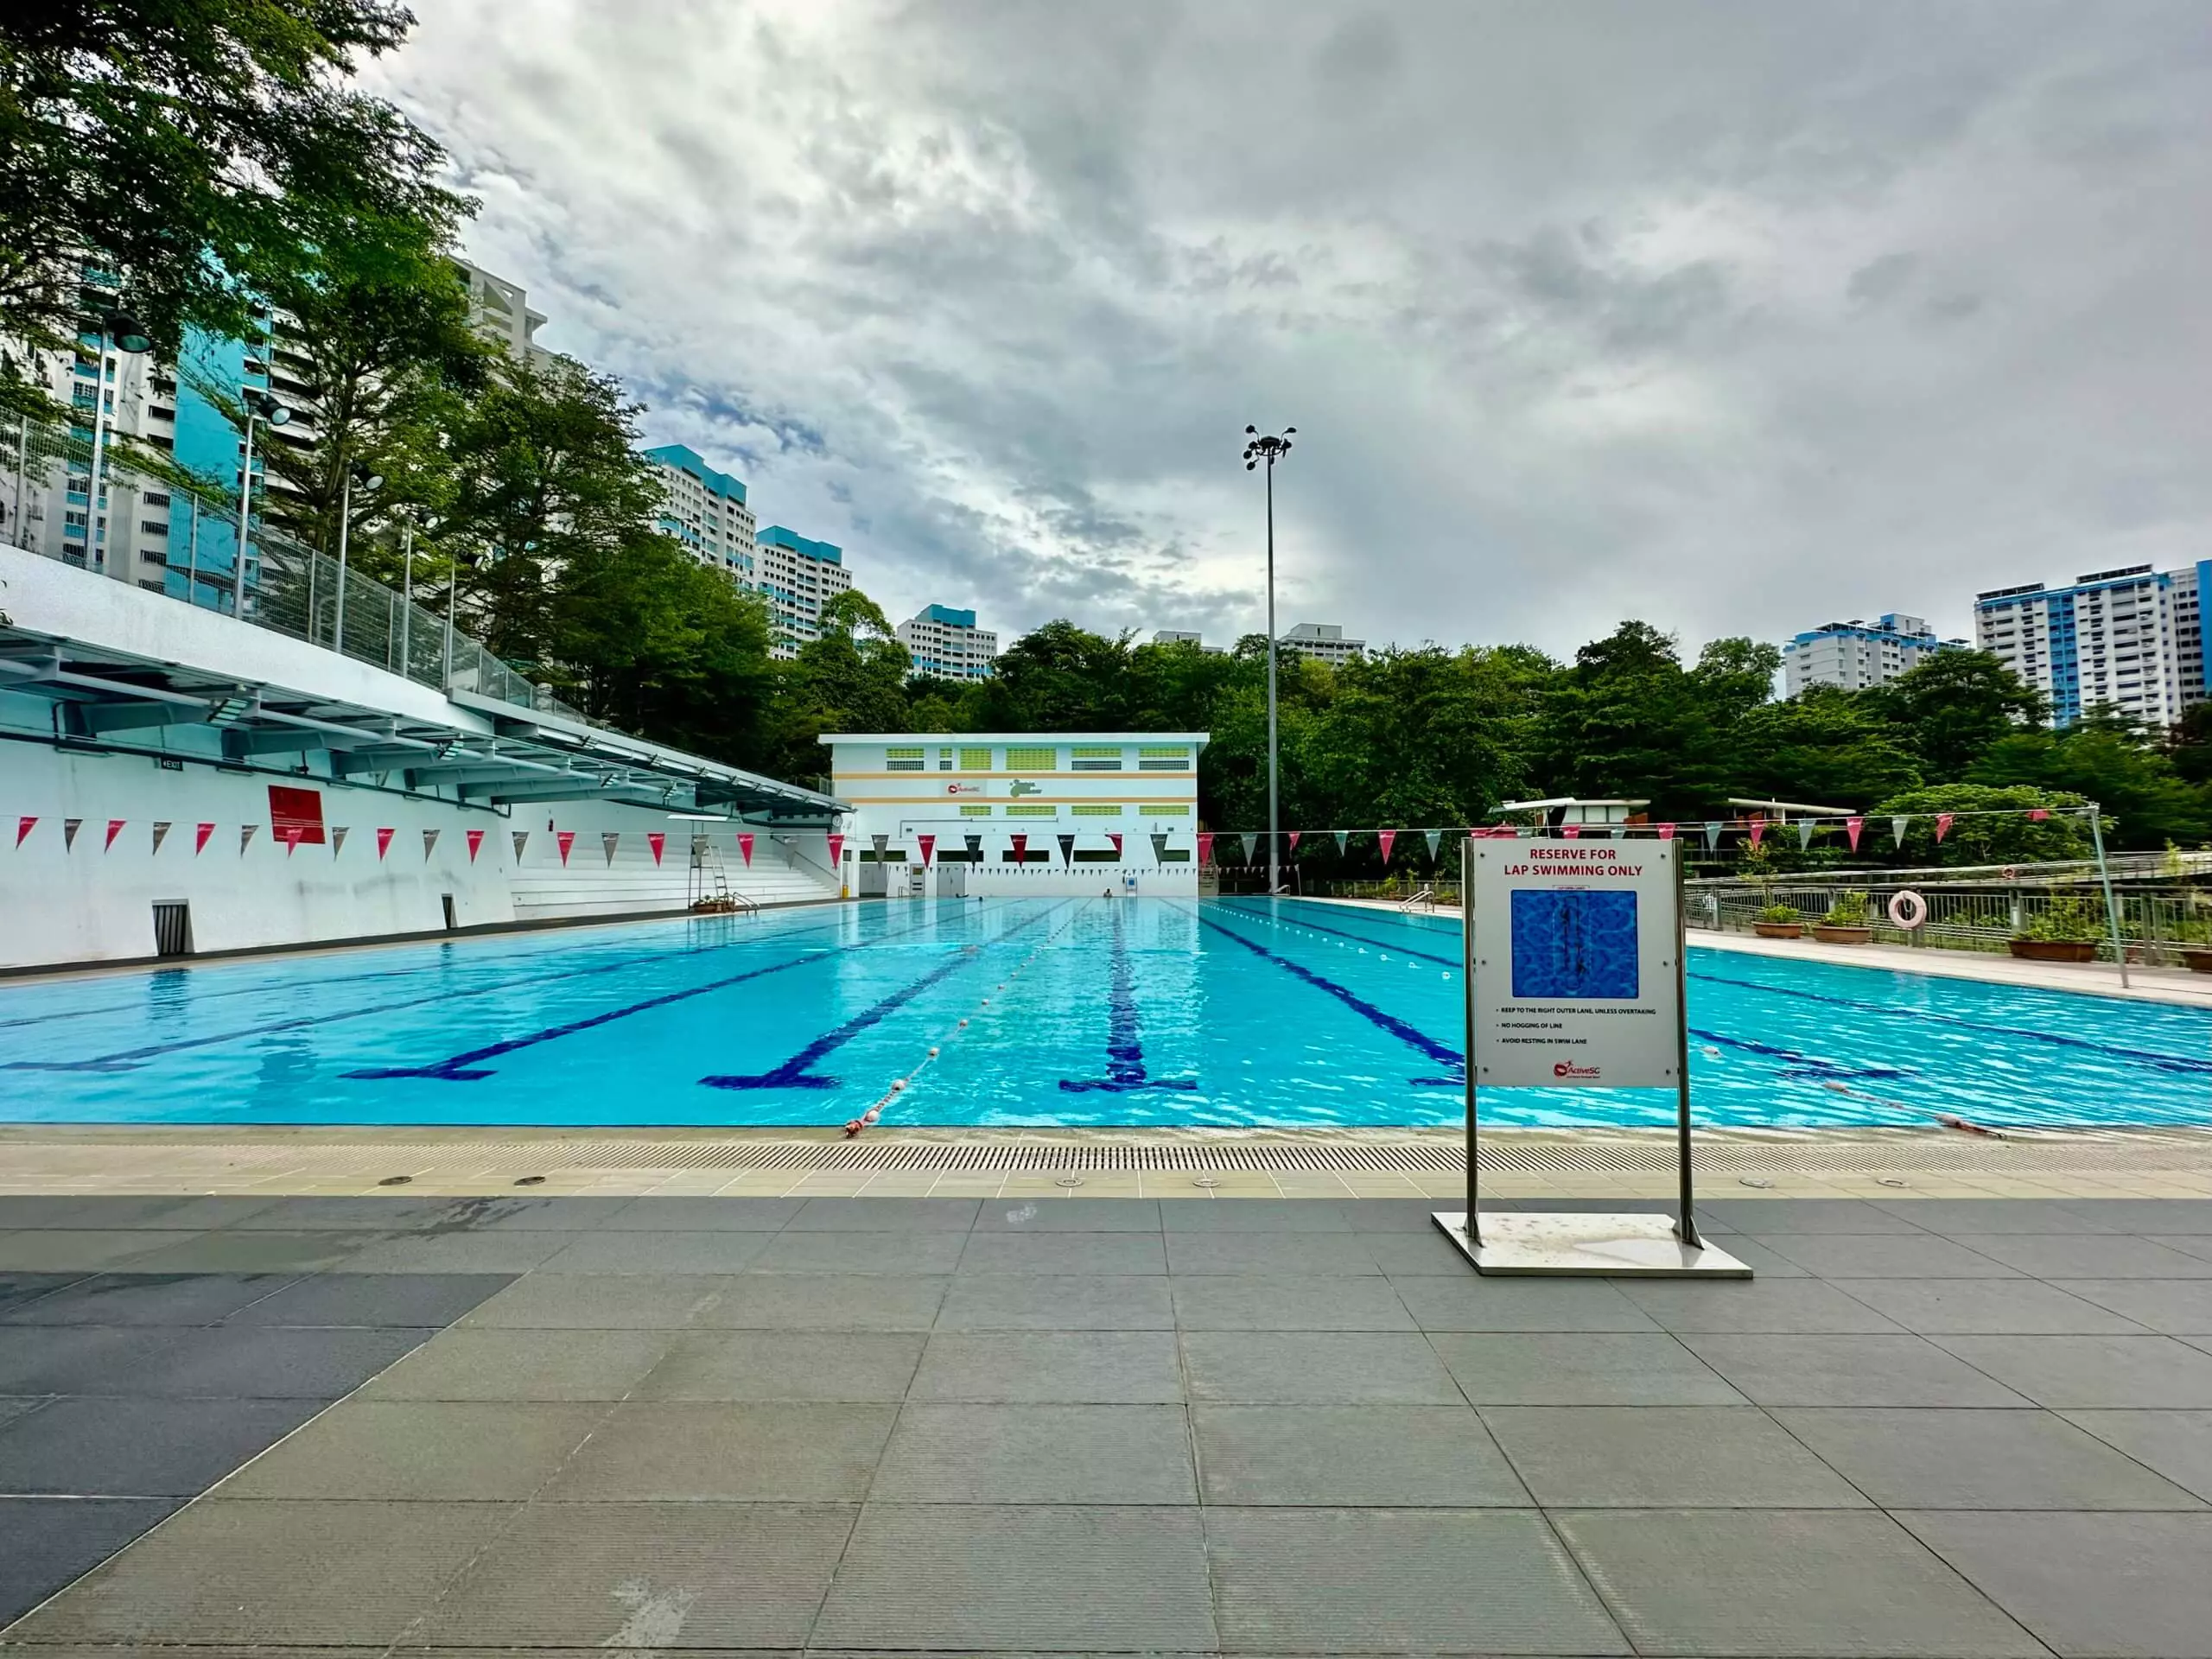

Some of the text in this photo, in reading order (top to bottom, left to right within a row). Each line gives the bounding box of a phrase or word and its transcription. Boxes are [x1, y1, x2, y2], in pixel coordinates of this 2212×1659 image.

[166, 760, 181, 769] EXIT
[1529, 849, 1616, 860] RESERVE FOR
[1503, 865, 1643, 876] LAP SWIMMING ONLY
